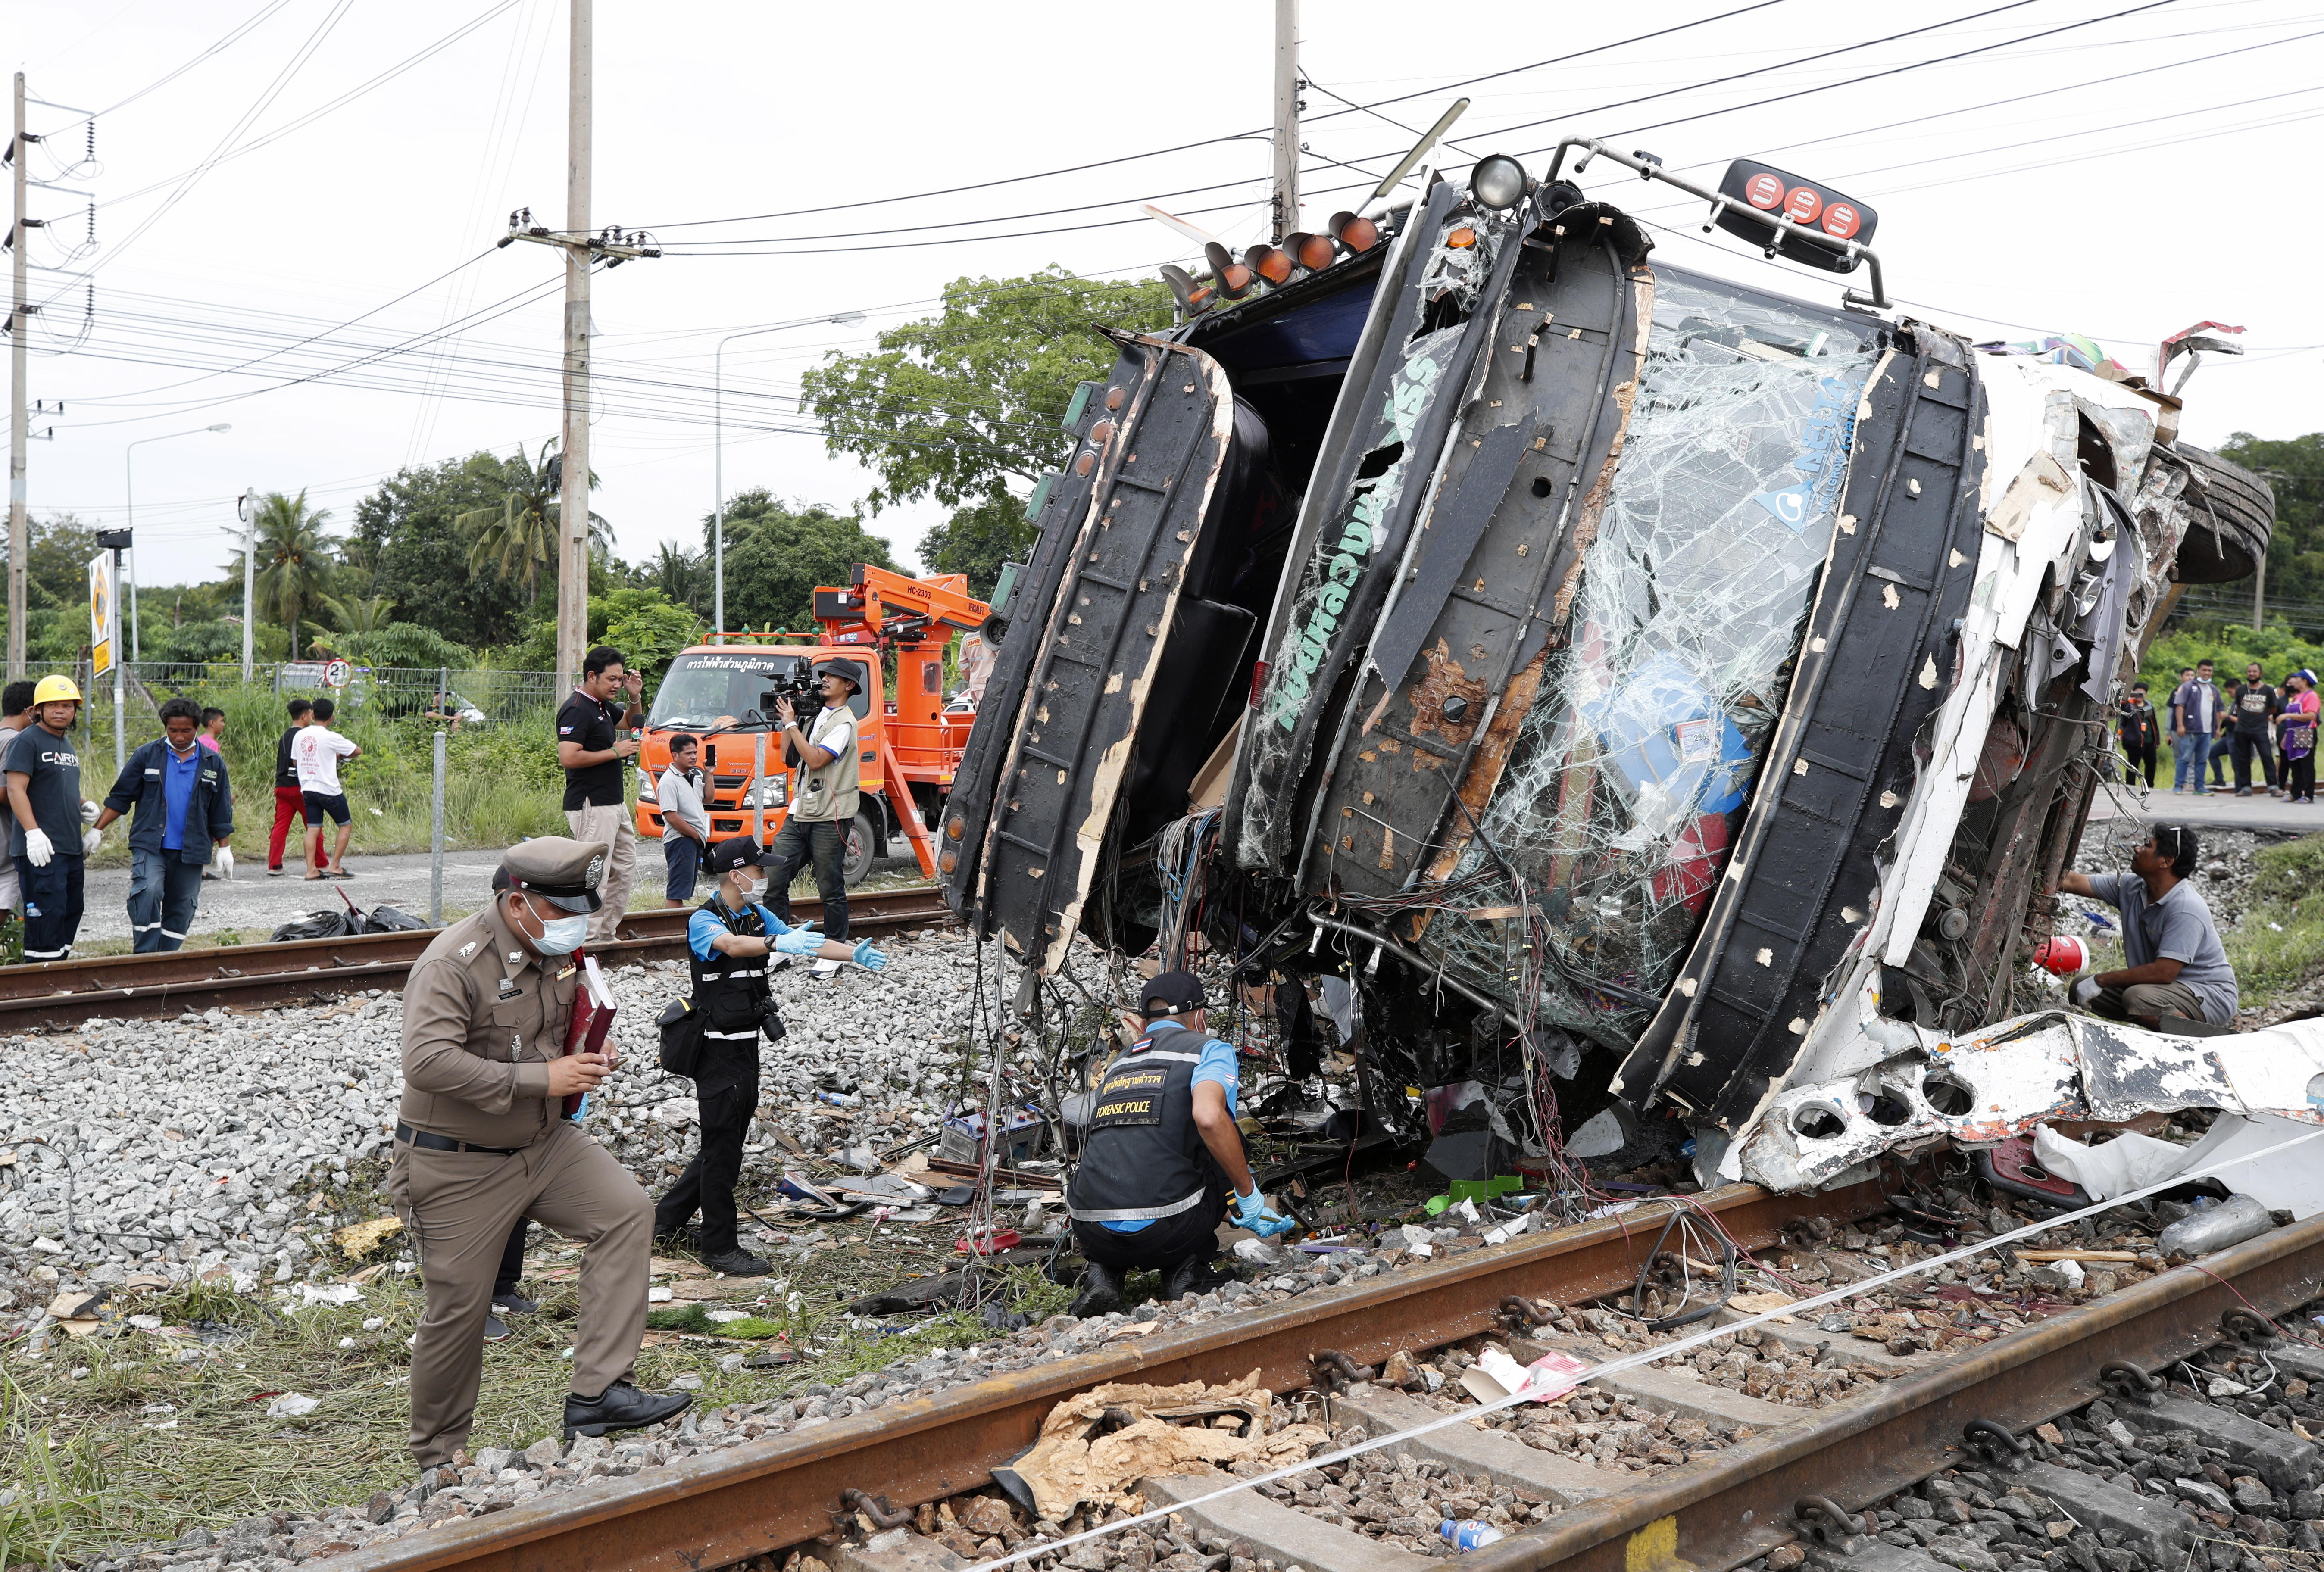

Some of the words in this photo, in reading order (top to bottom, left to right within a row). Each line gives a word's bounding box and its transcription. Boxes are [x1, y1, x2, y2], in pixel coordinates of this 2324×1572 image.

[1752, 177, 1777, 205] UD
[1790, 190, 1815, 218] UD
[1827, 206, 1853, 234] UD
[907, 585, 931, 599] HC-2303
[968, 602, 984, 615] VERSALIFT
[331, 664, 345, 676] 21
[687, 656, 775, 673] การไฟฟ้าส่วนภูมิภาค
[1096, 1103, 1126, 1119] FORENSIC
[1125, 1101, 1150, 1113] POLICE
